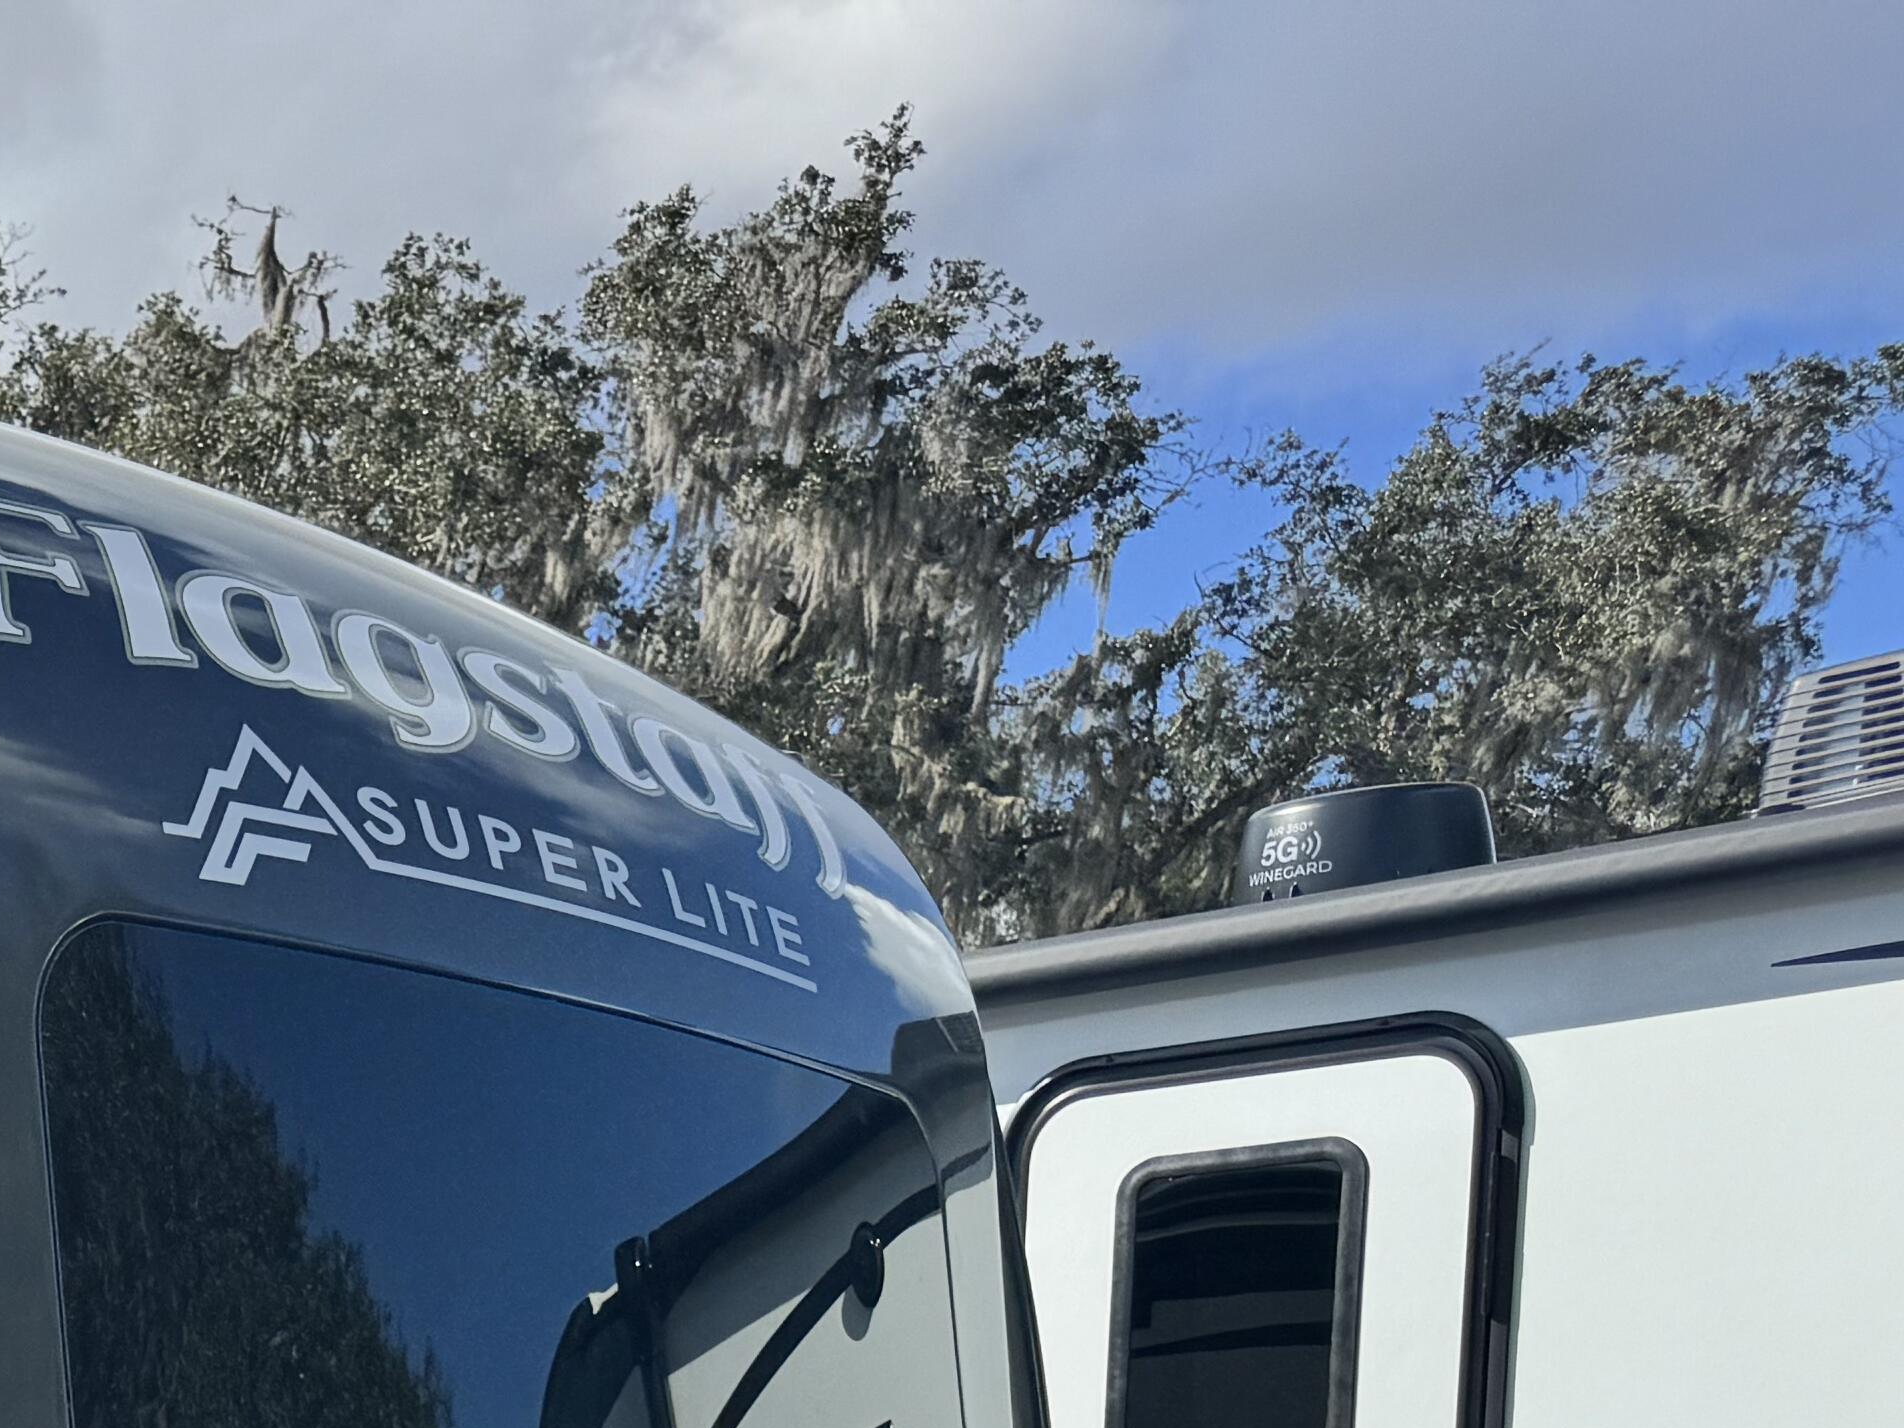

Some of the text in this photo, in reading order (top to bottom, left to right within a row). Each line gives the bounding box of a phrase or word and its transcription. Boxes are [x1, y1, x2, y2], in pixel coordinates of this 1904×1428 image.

[1260, 836, 1298, 867] 5G
[356, 784, 811, 967] SUPER LITE
[1248, 860, 1332, 887] WINEGARD
